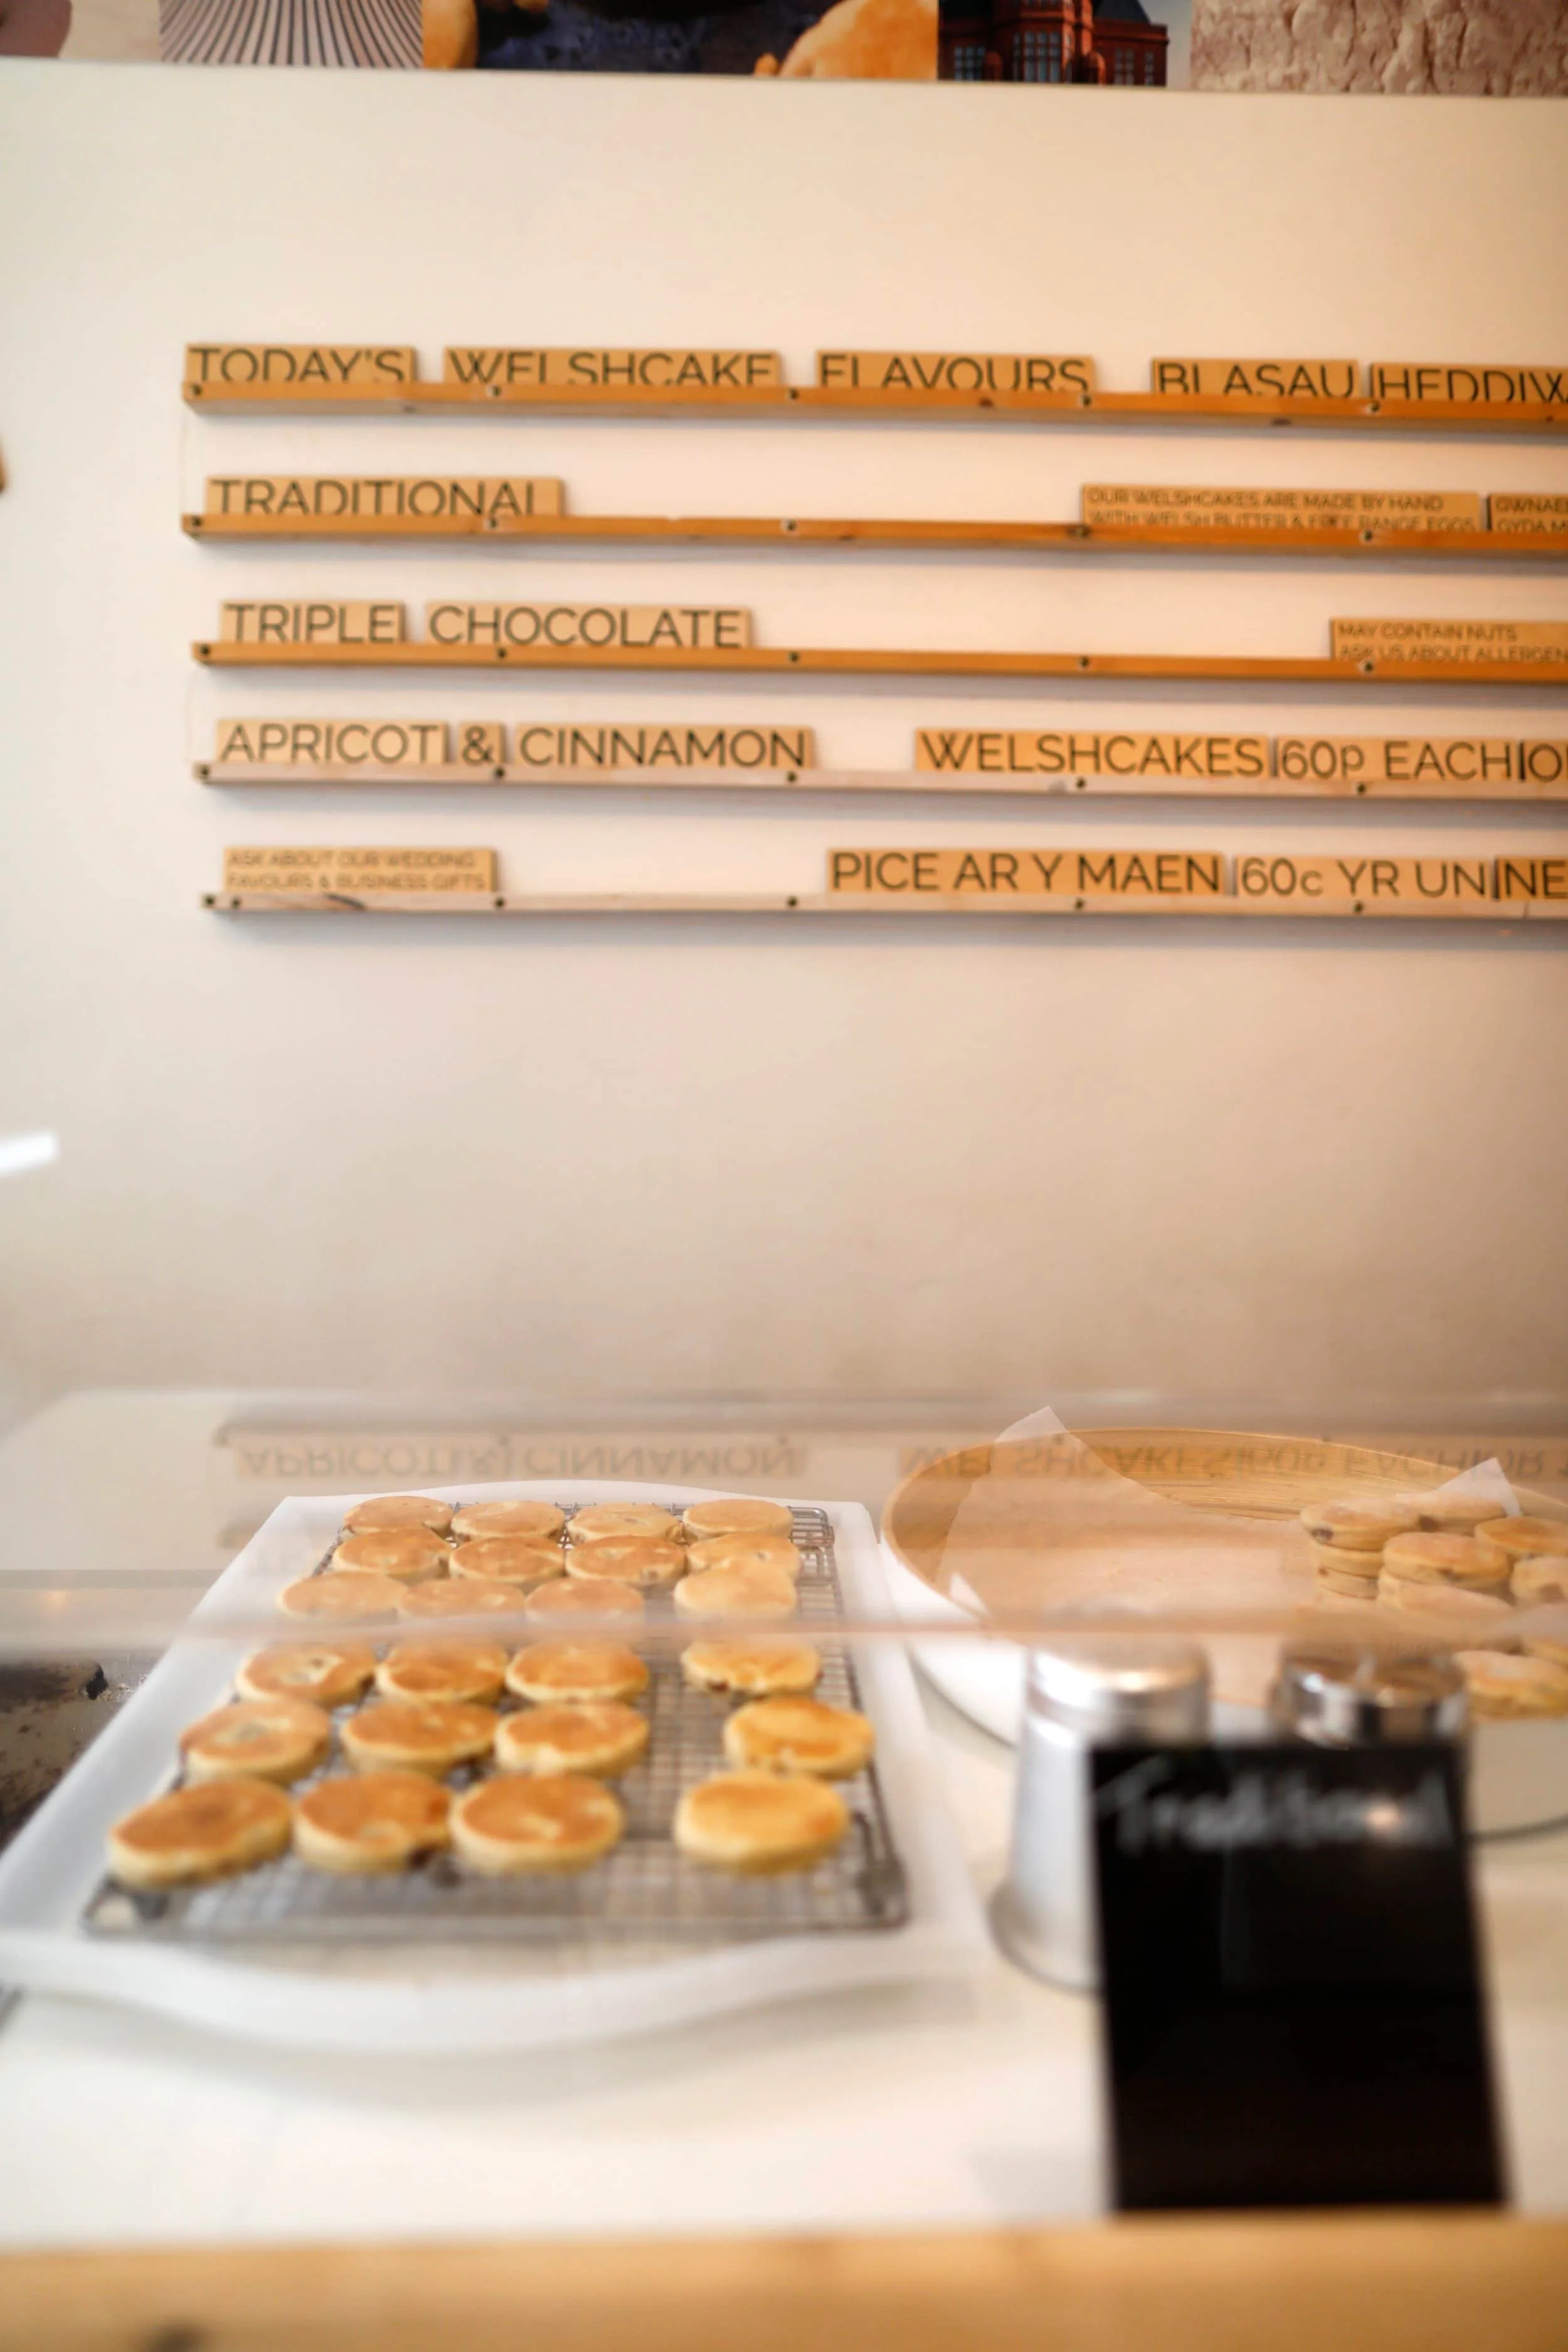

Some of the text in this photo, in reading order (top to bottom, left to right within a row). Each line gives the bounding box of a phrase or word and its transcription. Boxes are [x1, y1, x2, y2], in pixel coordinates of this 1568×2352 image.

[190, 348, 1088, 392] TODAY'S WELSHCAKE FLAVOURS
[1158, 363, 1354, 399] BLASAU
[213, 480, 534, 516] TRADITIONAL
[1086, 487, 1128, 504] OUR
[1303, 493, 1355, 511] MADE
[1362, 495, 1384, 511] BY
[1388, 495, 1443, 512] HAND
[225, 604, 741, 649] TRIPLE CHOCOLATE
[1338, 622, 1518, 642] MAY CONTAIN NUTS
[220, 723, 805, 768] APRICOT & CINNAMON
[921, 733, 1568, 782] WELSHCAKES 60p EACH O
[832, 852, 939, 892] PICE
[1078, 854, 1219, 893] MAEN
[1242, 857, 1325, 896] 60c
[1337, 859, 1400, 897] YR
[1415, 861, 1486, 898] UN
